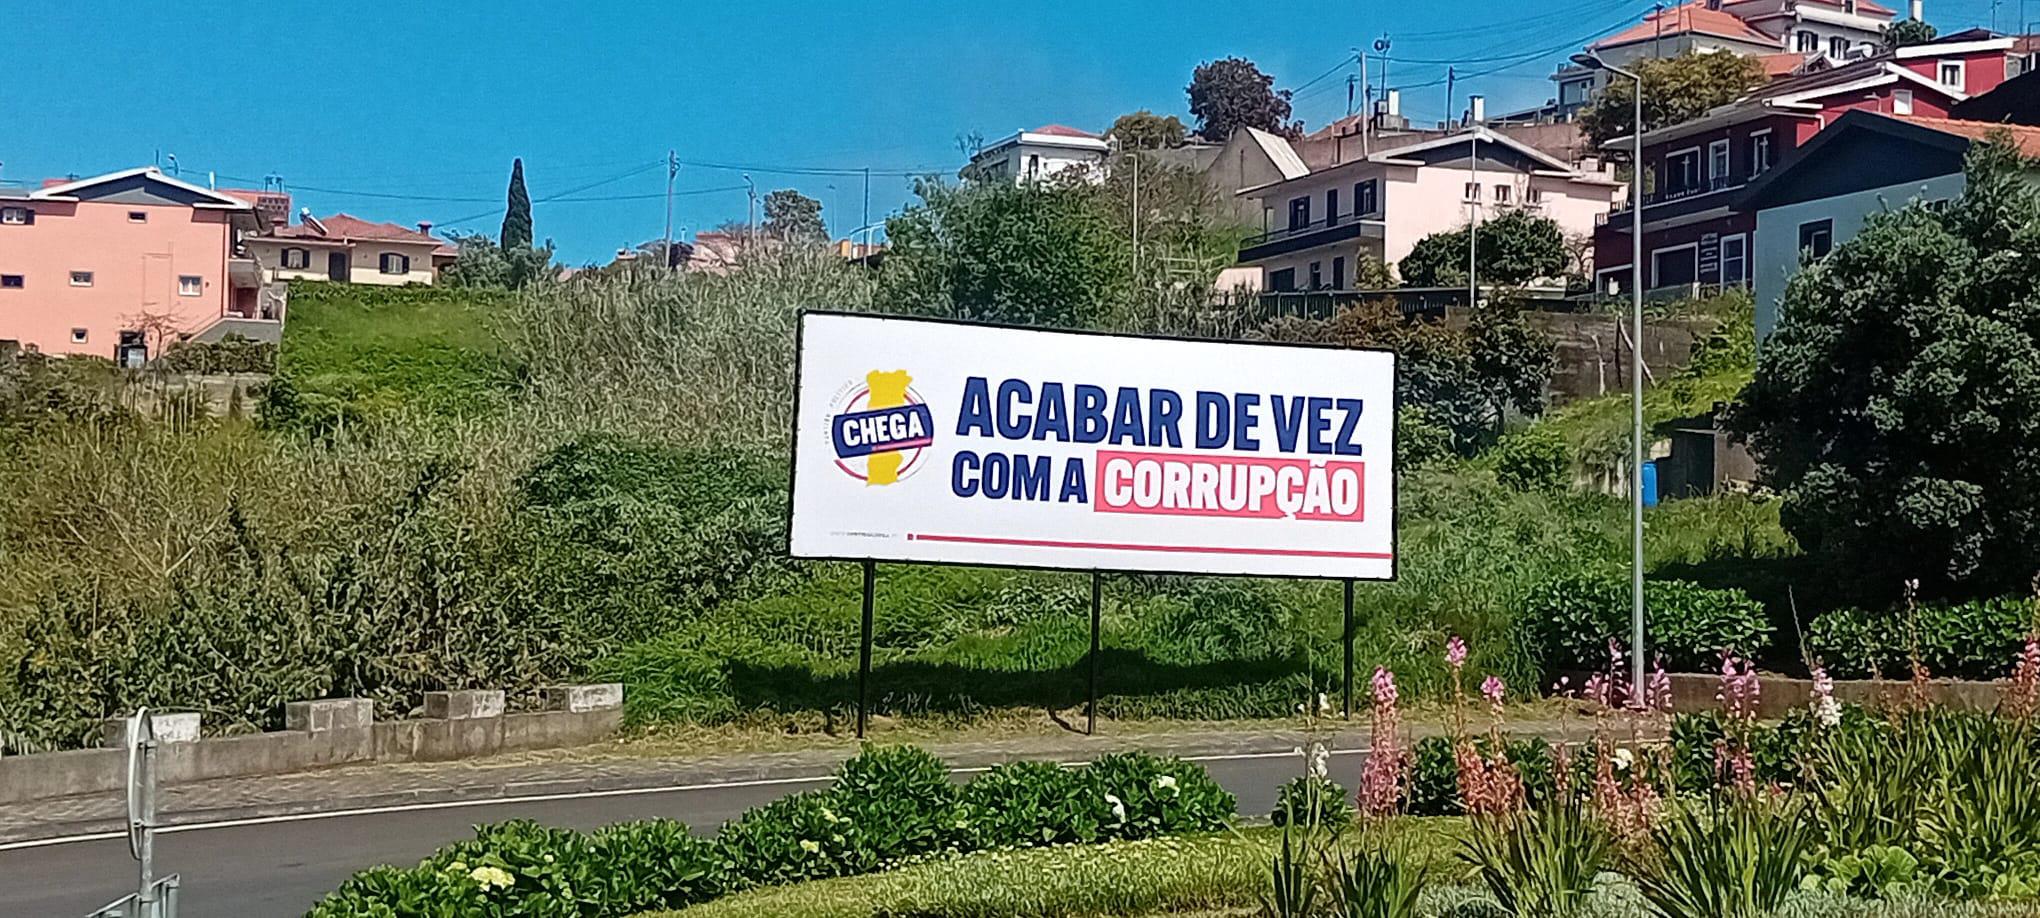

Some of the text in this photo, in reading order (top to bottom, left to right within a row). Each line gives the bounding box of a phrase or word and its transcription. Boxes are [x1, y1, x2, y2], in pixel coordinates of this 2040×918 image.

[842, 411, 926, 447] CHEGA
[955, 376, 1364, 456] ACABAR DE VEZ
[951, 450, 1361, 520] COM A CORRUPÇÃO
